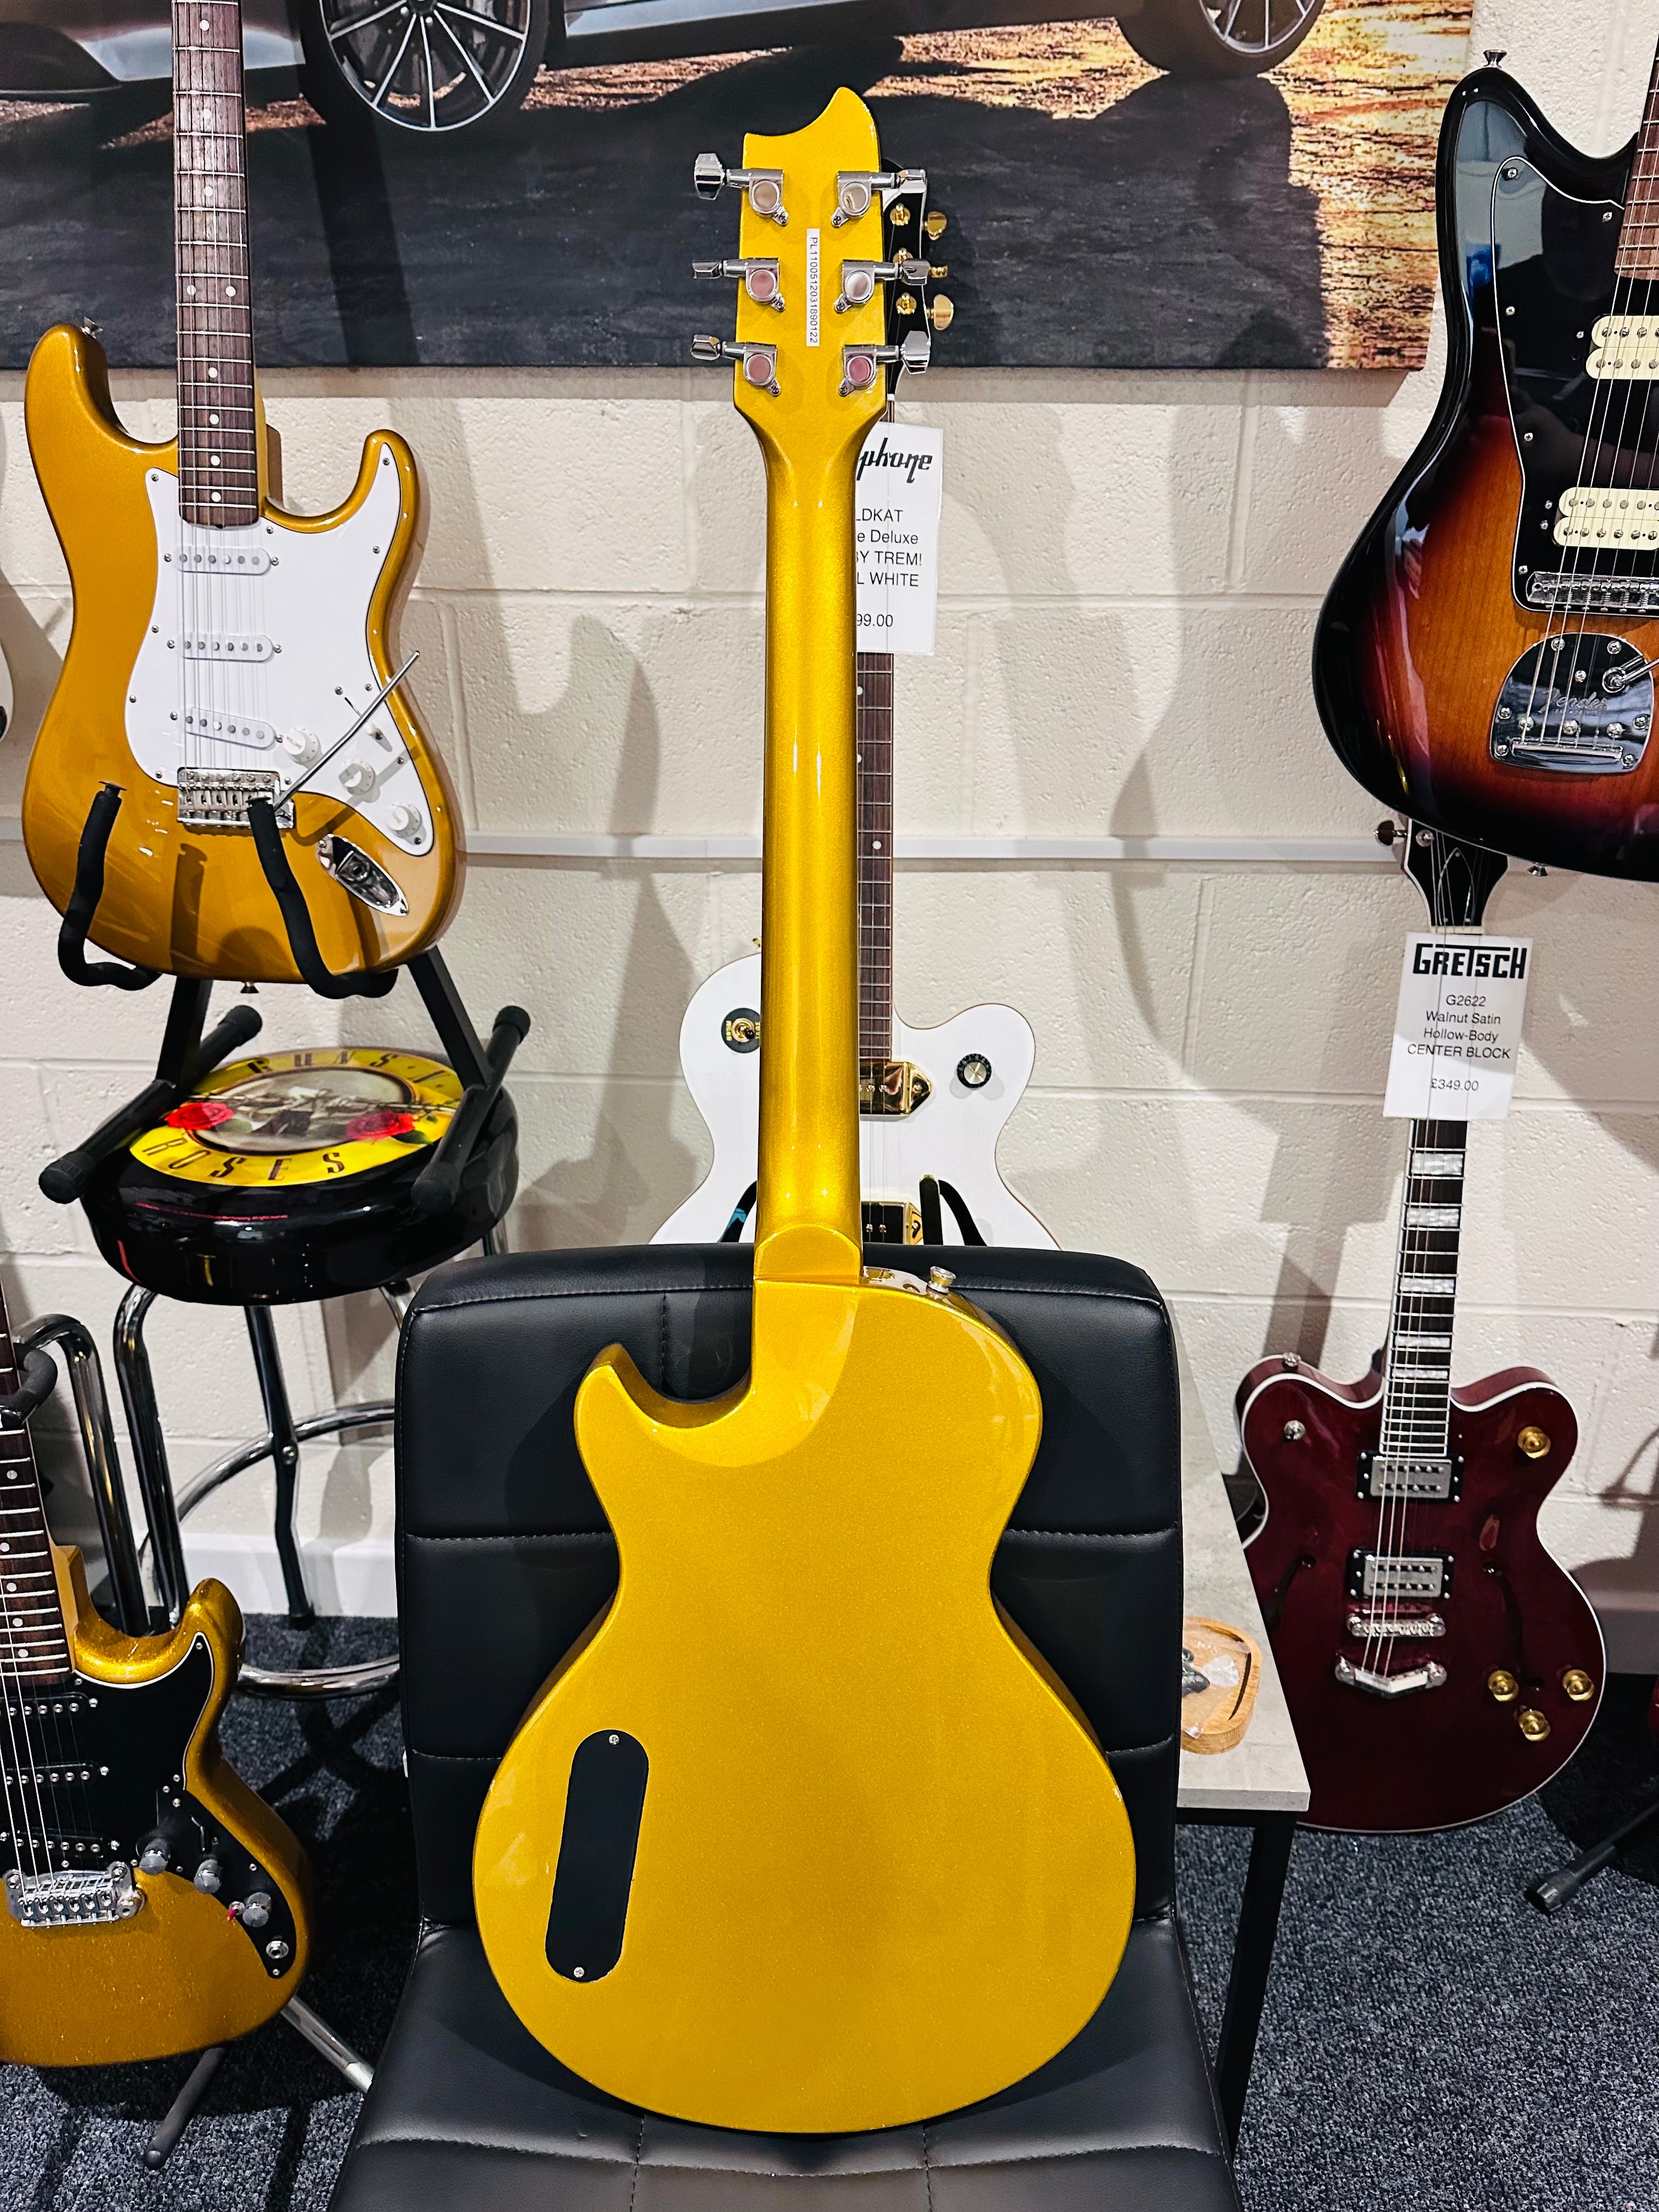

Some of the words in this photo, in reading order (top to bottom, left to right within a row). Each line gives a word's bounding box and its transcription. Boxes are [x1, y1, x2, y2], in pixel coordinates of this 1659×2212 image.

[810, 237, 818, 343] PL1100512031890122
[871, 529, 918, 544] Deluxe
[874, 551, 922, 566] TREM!
[870, 572, 919, 587] WHITE
[1413, 943, 1527, 979] GRETSCH
[1446, 995, 1486, 1007] G2622
[1426, 1011, 1468, 1024] Walnut
[1472, 1013, 1501, 1025] Satin
[1423, 1028, 1499, 1044] Hollow-Body
[1407, 1043, 1462, 1057] CENTER
[1466, 1047, 1511, 1059] BLOCK
[1431, 1079, 1479, 1091] £349.00
[142, 1137, 345, 1181] ROSES
